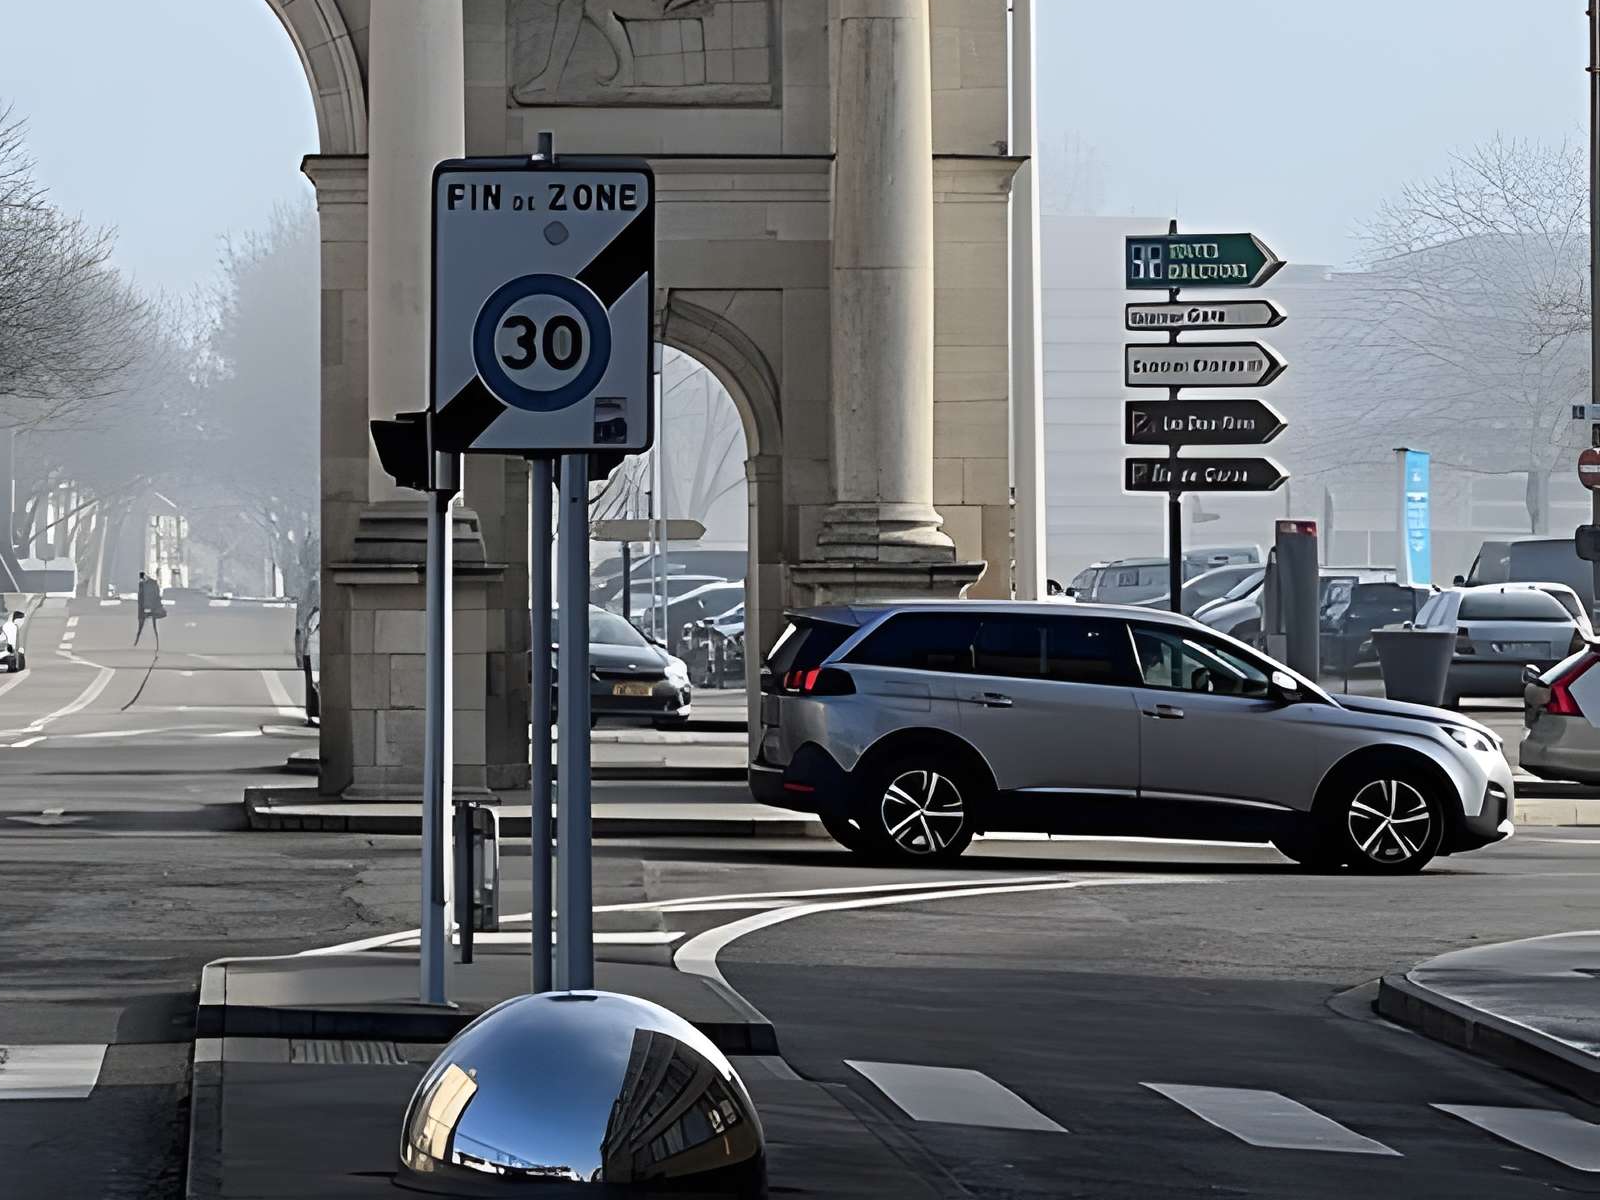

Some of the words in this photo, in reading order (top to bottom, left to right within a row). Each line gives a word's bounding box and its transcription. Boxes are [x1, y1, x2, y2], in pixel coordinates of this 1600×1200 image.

[447, 183, 501, 211] FIN
[548, 183, 638, 211] ZONE
[501, 314, 583, 370] 30
